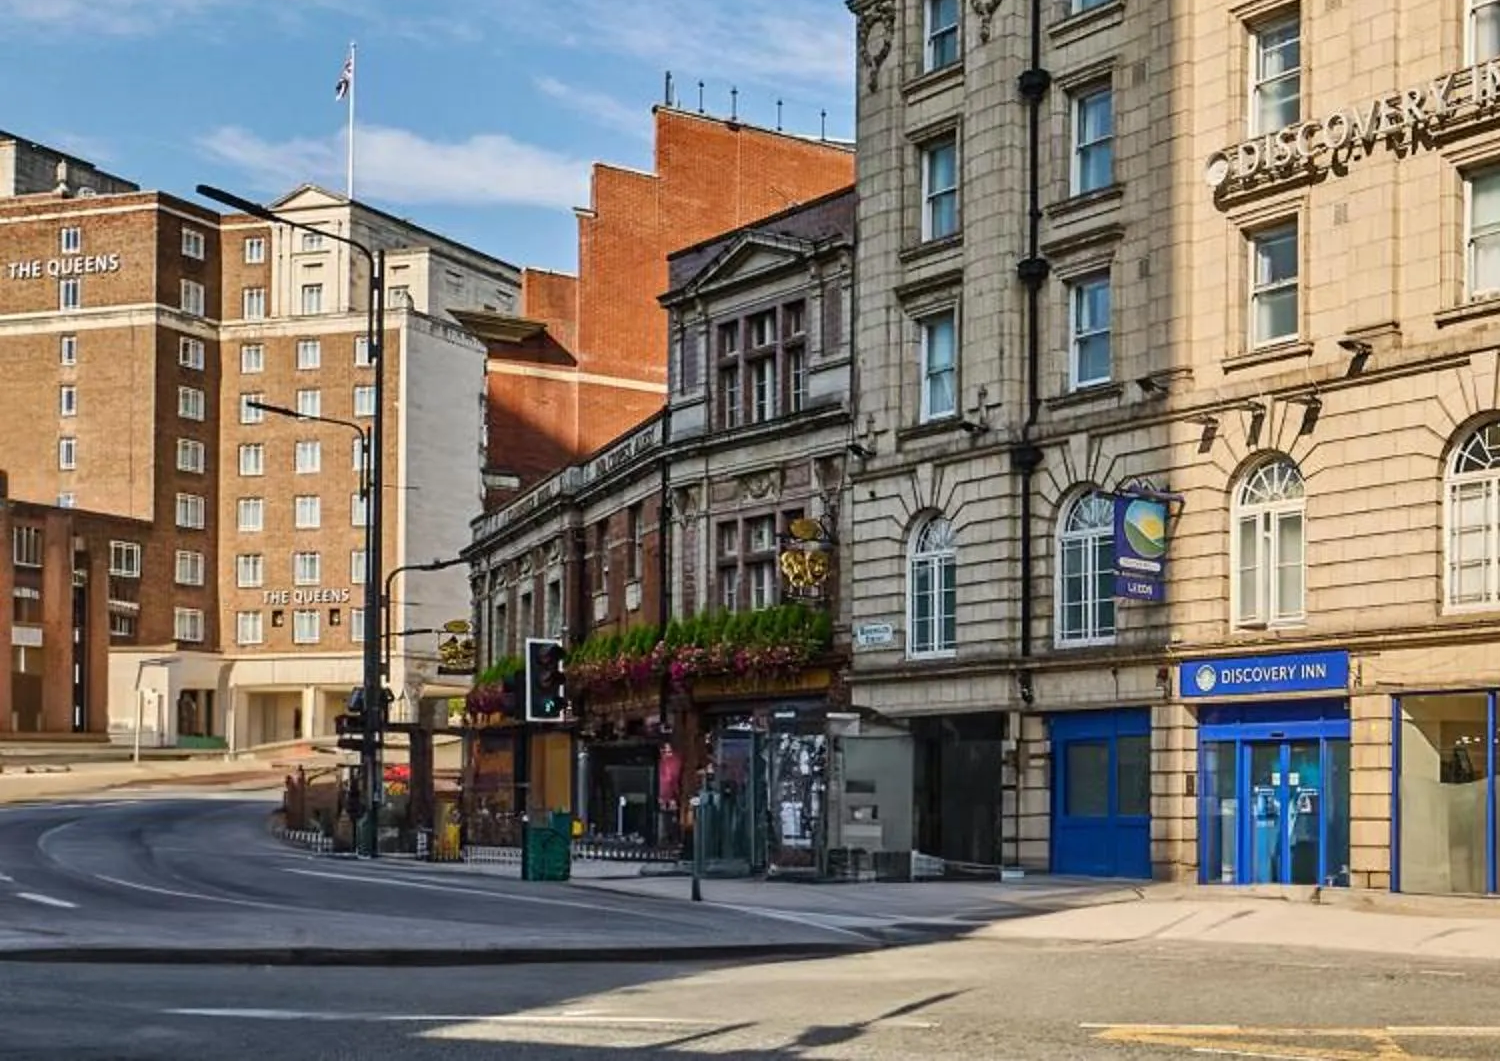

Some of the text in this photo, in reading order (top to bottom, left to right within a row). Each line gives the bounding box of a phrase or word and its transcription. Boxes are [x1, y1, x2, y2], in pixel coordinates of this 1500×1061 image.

[1237, 76, 1453, 176] DISCOVERY
[8, 253, 120, 279] THE QUEENS
[263, 588, 350, 605] THE QUEENS
[1221, 664, 1327, 684] DISCOVERY INN
